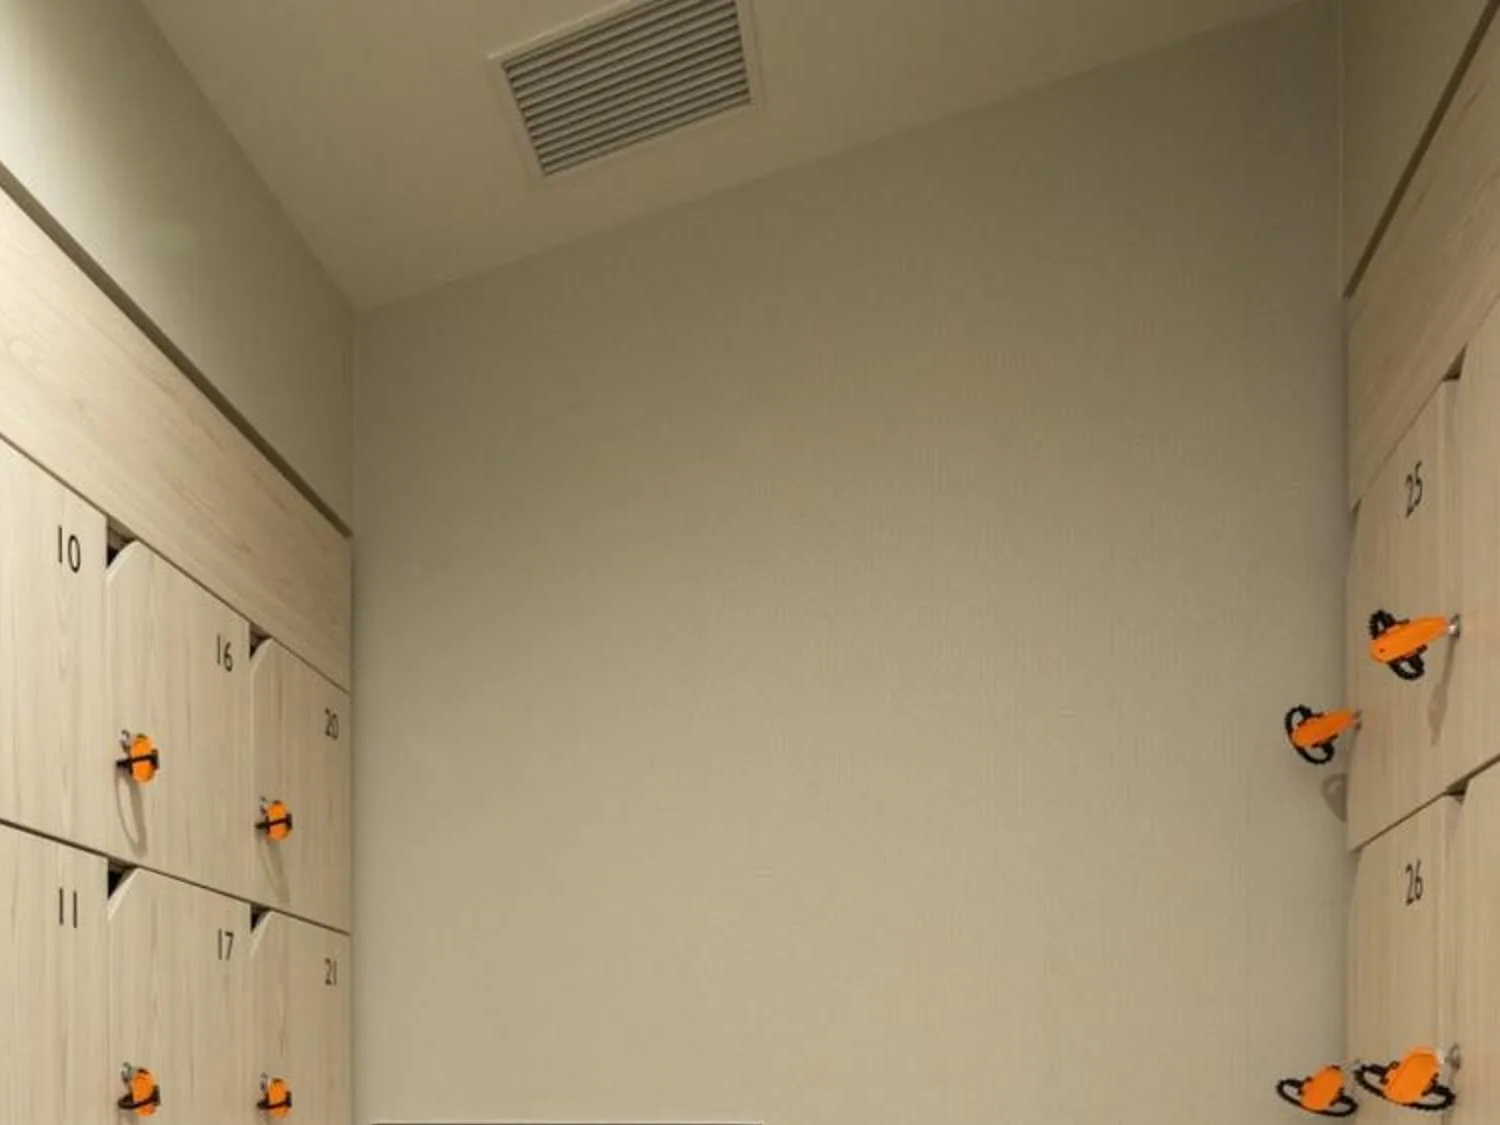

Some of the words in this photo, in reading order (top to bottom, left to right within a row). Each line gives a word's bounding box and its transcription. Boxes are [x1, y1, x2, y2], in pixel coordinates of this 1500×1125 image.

[1405, 460, 1423, 518] 25
[57, 525, 82, 574] 10
[216, 634, 234, 673] 16
[324, 707, 339, 741] 20
[1405, 859, 1423, 906] 26
[58, 887, 78, 929] 11
[217, 928, 235, 961] 17
[324, 957, 338, 986] 21
